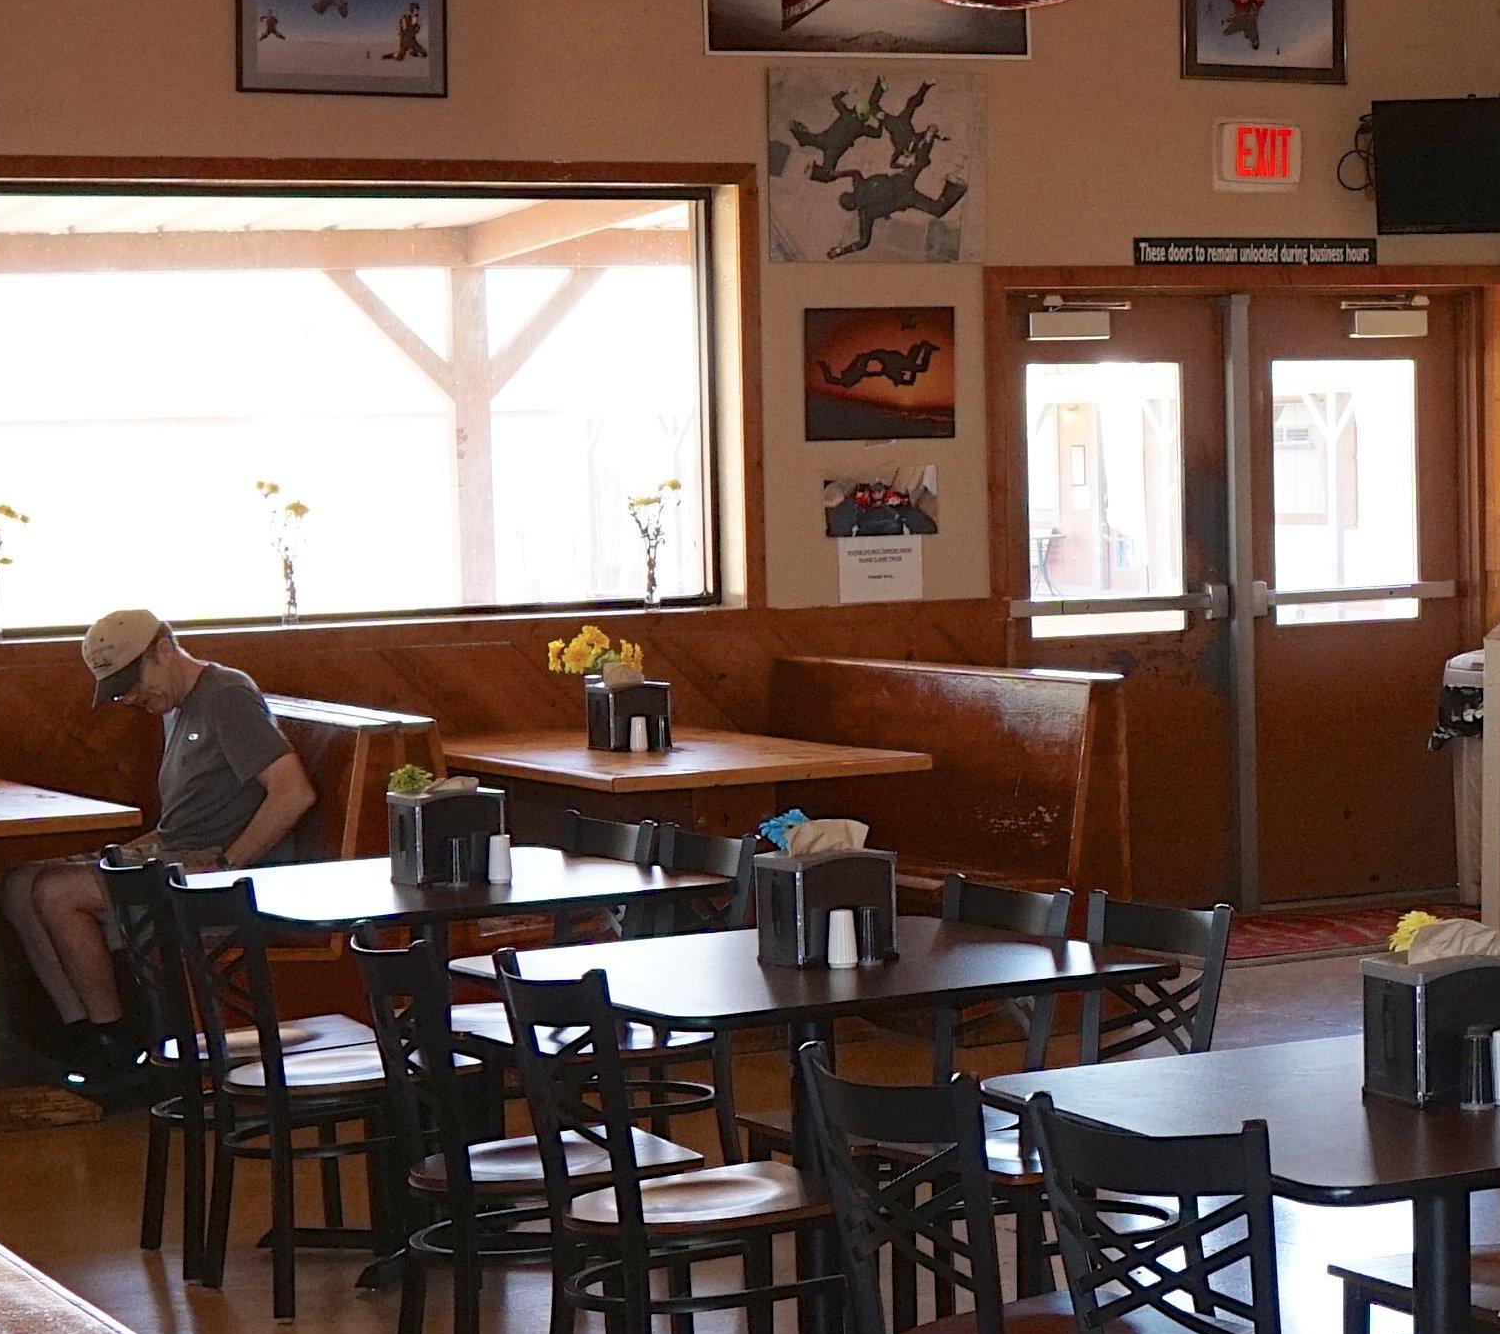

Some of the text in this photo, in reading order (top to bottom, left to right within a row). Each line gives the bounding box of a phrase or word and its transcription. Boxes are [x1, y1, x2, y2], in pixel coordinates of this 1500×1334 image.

[1236, 126, 1293, 178] EXIT
[1139, 242, 1370, 265] These doors to remain unlocked during business hours
